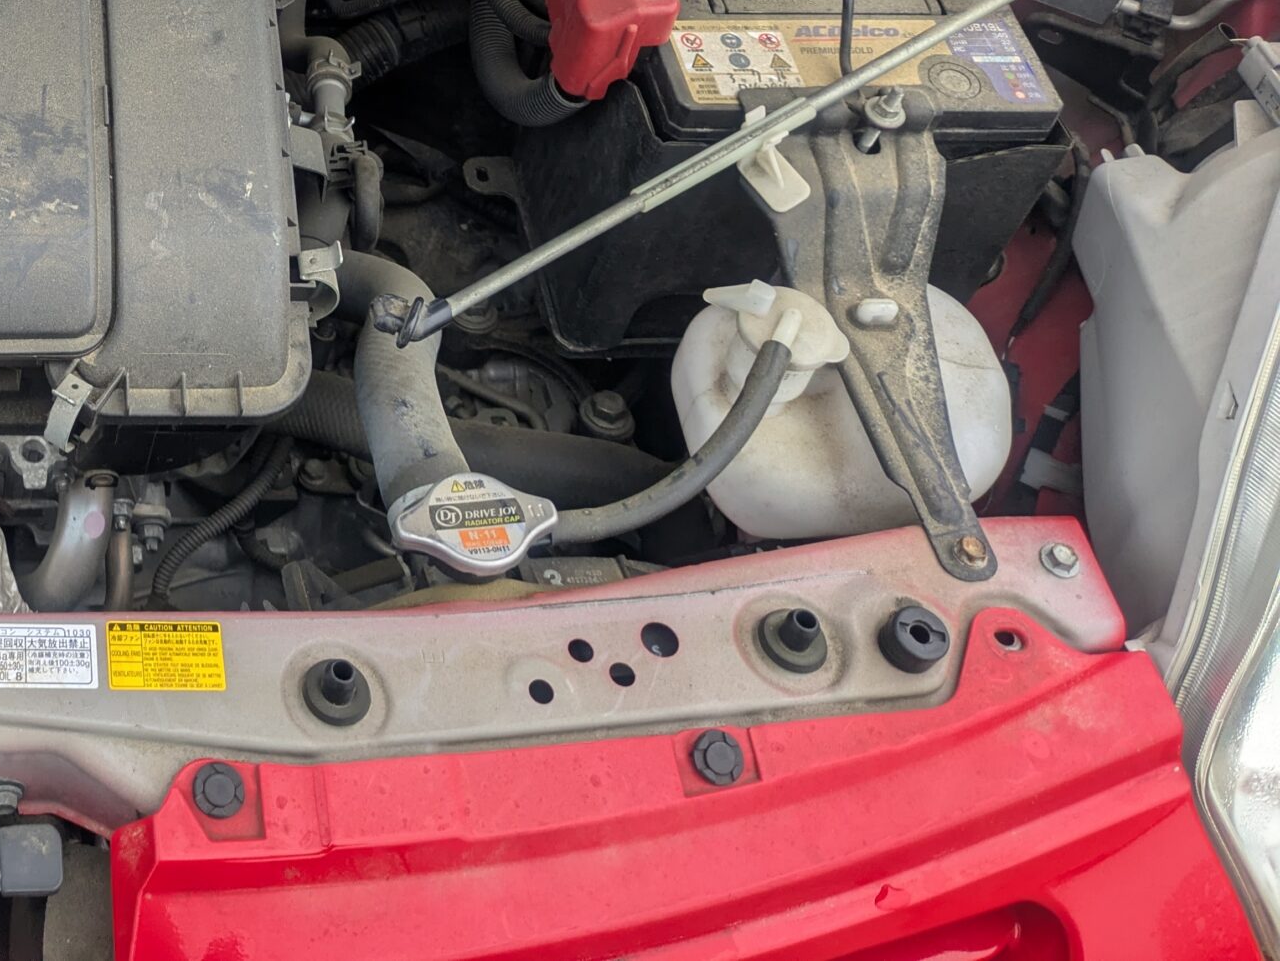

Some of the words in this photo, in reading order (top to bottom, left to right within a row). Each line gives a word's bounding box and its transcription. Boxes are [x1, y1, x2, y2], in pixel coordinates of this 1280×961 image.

[799, 46, 842, 55] PREMIU
[440, 509, 457, 524] DJ
[465, 508, 497, 519] DRIVE
[498, 506, 517, 517] JOY
[465, 517, 503, 526] RADIATOR
[504, 515, 520, 523] CAP
[26, 628, 60, 636] システム
[176, 624, 212, 632] ATTENTION
[66, 629, 91, 637] 1030
[27, 638, 89, 649] 大気放出禁止
